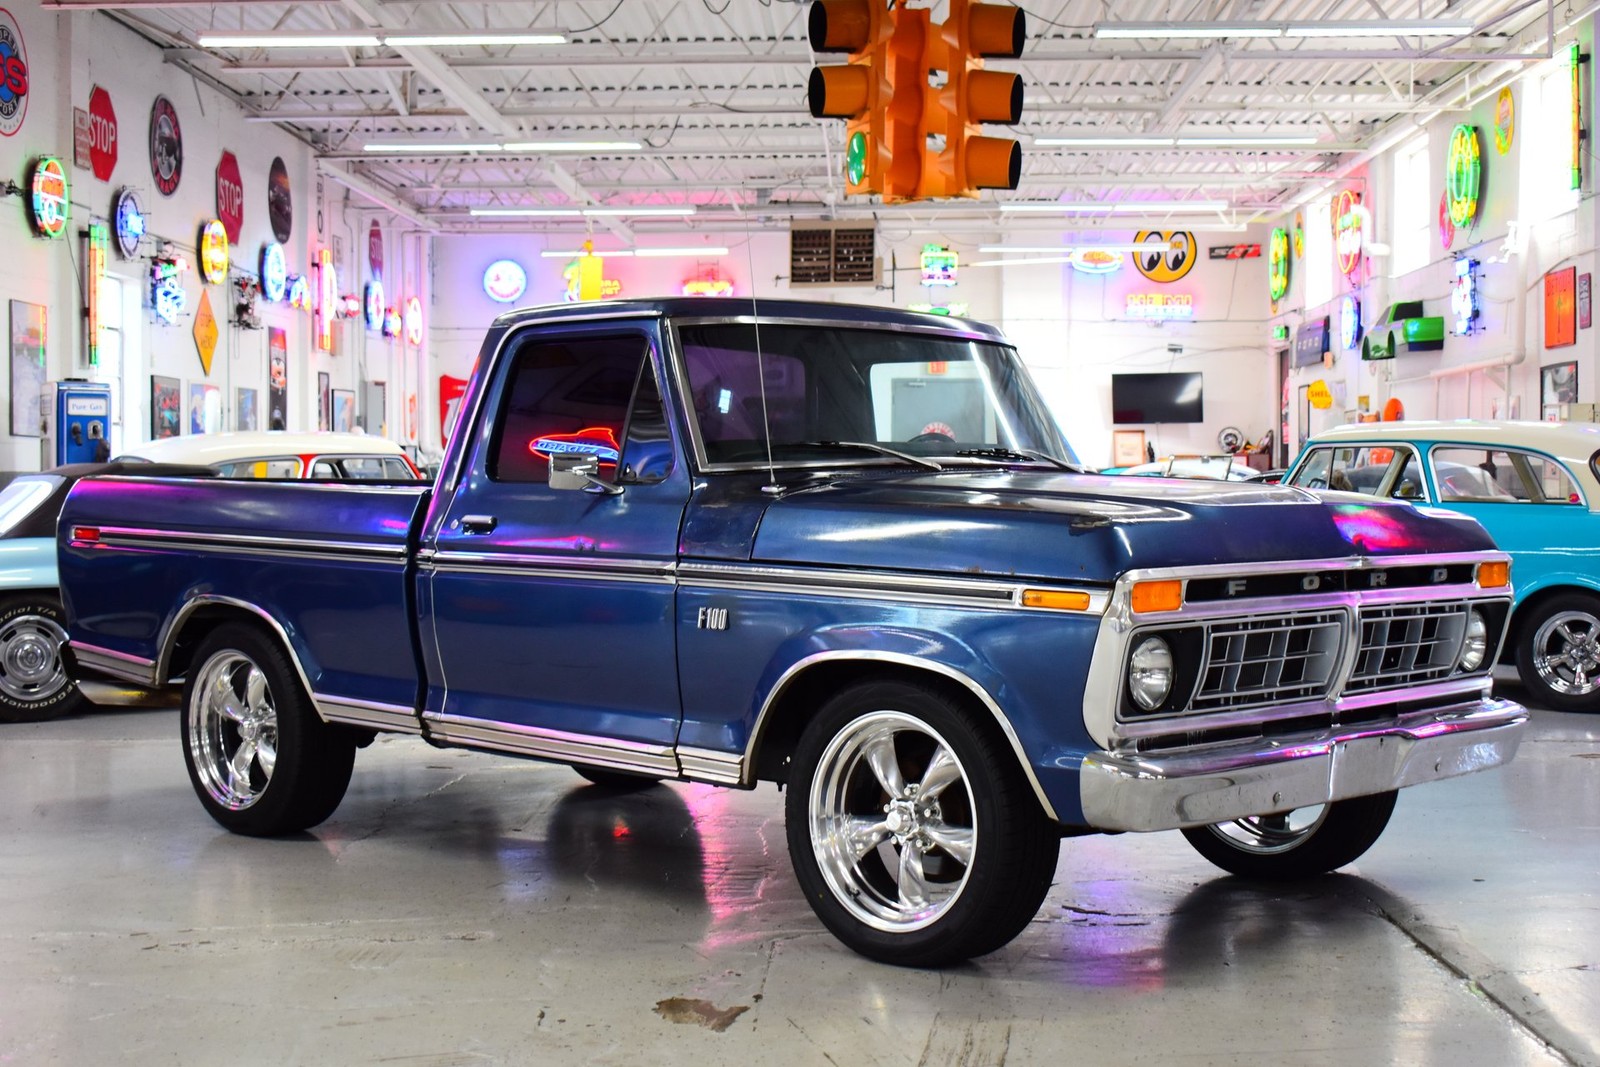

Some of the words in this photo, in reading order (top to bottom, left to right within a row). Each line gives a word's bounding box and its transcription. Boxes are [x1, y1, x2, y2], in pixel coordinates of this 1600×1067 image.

[88, 113, 116, 155] STOP
[220, 177, 242, 218] STOP
[1228, 568, 1448, 595] FORD
[37, 606, 57, 617] T/A
[697, 606, 727, 631] F100
[0, 681, 76, 710] FGoodrich
